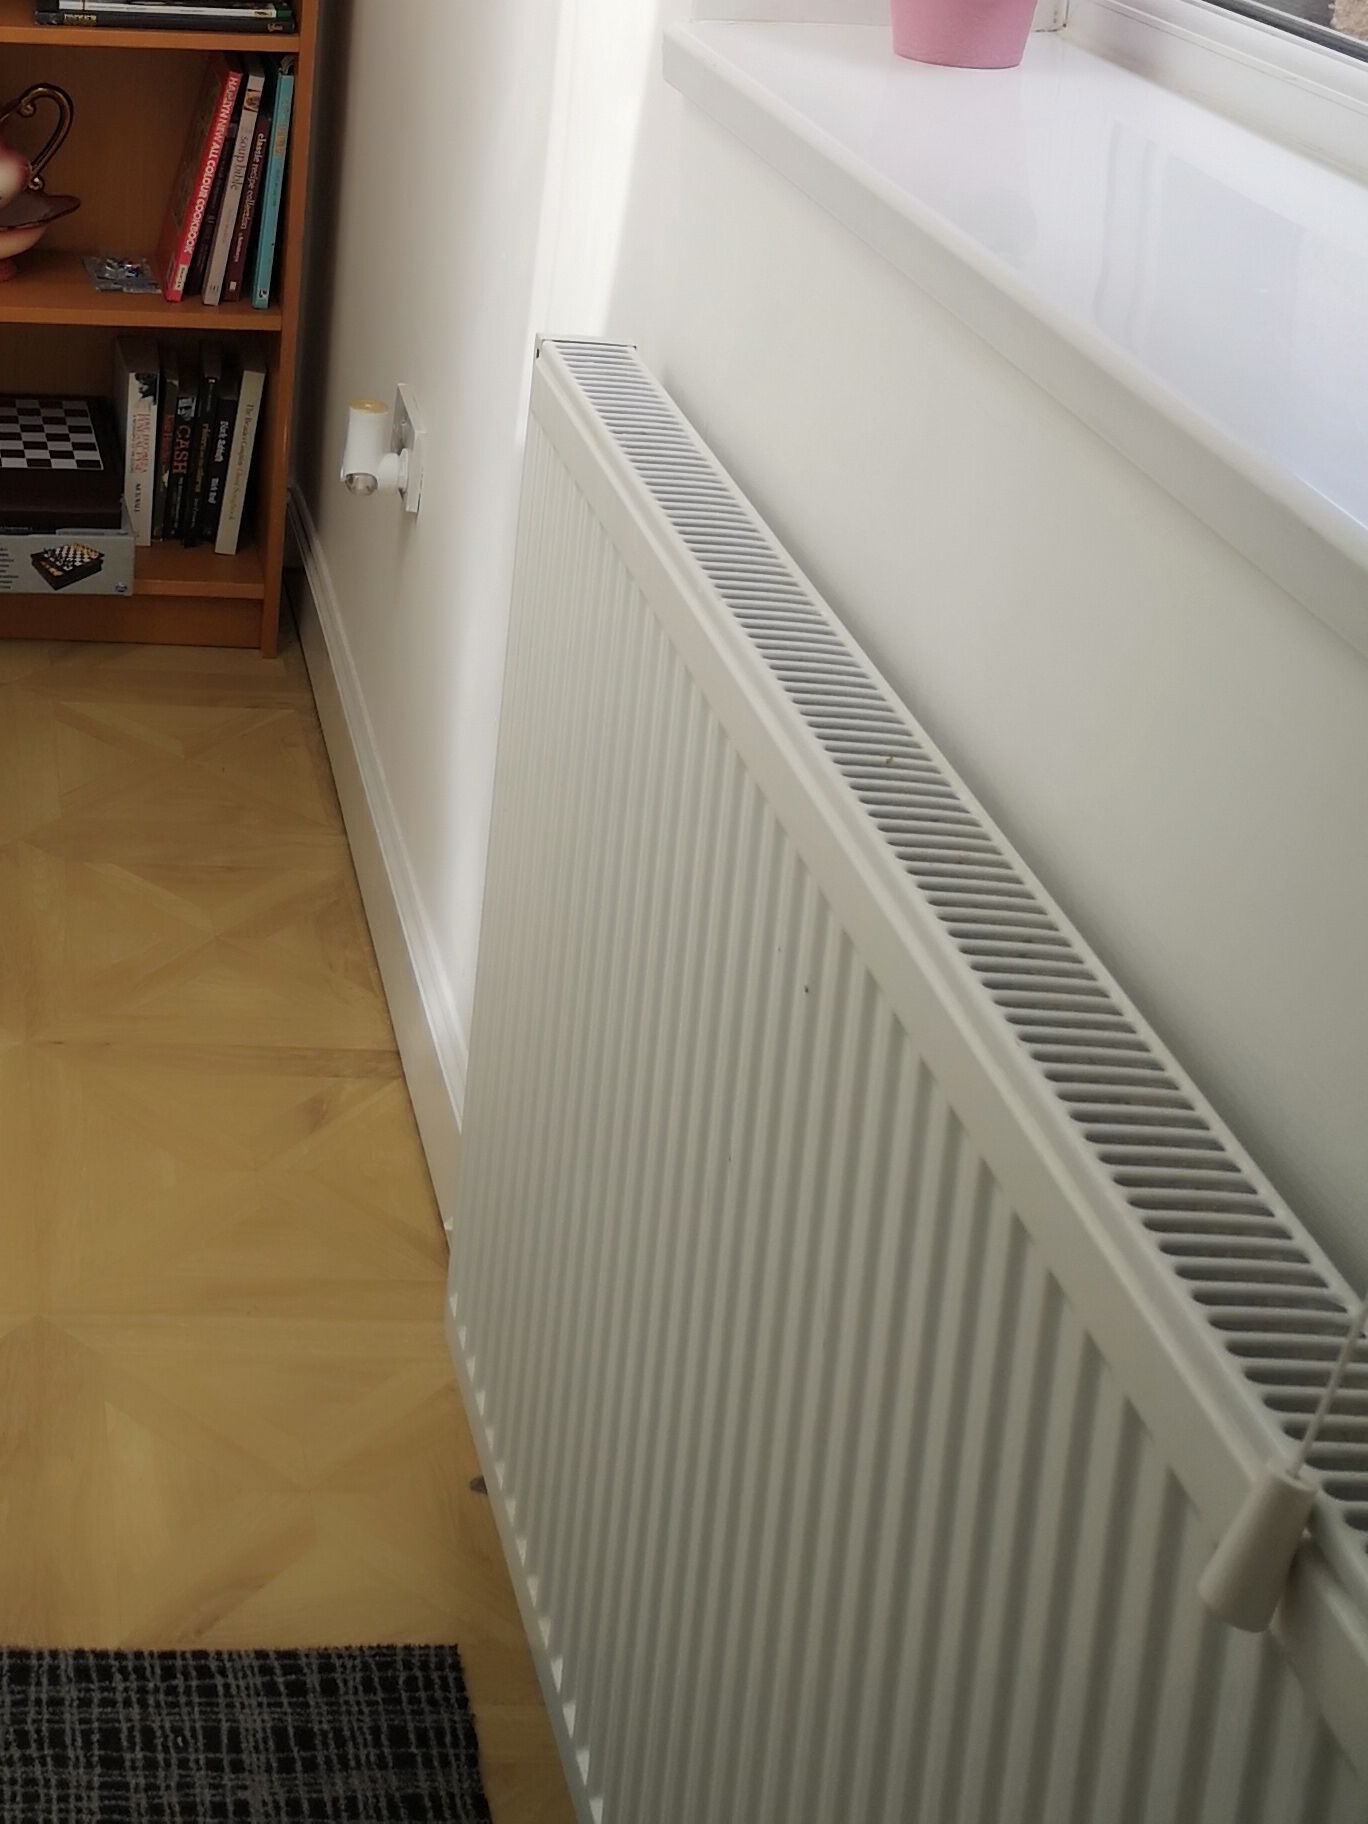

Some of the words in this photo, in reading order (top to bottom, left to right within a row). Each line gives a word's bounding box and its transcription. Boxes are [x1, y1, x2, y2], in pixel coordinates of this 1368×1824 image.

[213, 119, 226, 144] NEW
[208, 141, 222, 159] ALL
[234, 135, 248, 163] soup
[252, 132, 267, 163] classic
[198, 160, 216, 198] COLOUR
[230, 164, 246, 191] bible
[247, 164, 260, 189] recipe
[241, 190, 256, 229] collection
[183, 198, 206, 254] COOKBOOK
[172, 425, 191, 475] CASH
